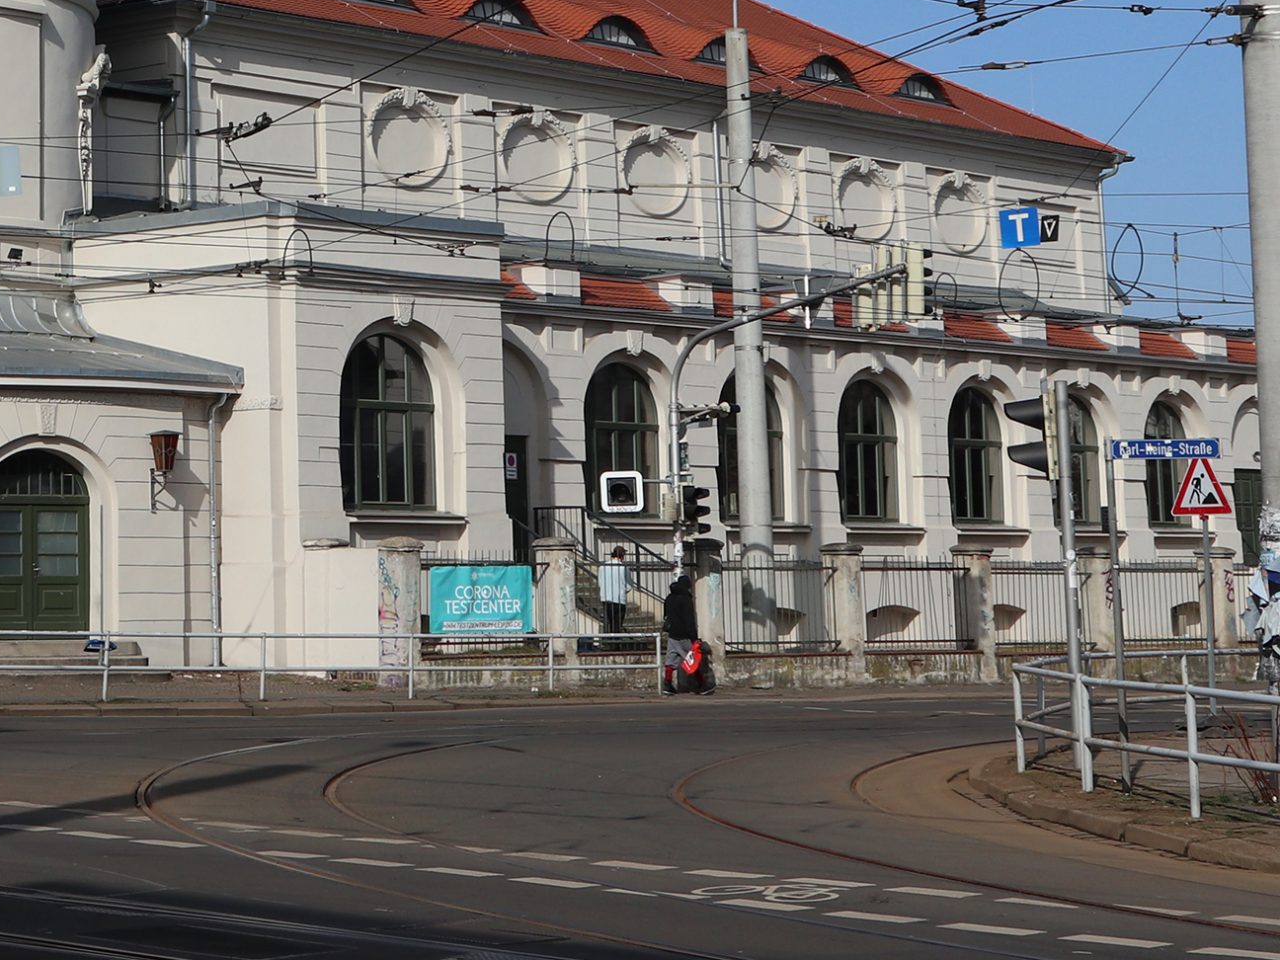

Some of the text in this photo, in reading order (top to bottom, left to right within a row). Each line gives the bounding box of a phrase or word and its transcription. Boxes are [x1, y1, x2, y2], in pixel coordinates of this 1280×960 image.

[1008, 213, 1029, 242] T
[454, 585, 511, 600] CORONA
[444, 599, 521, 615] TESTCENTER
